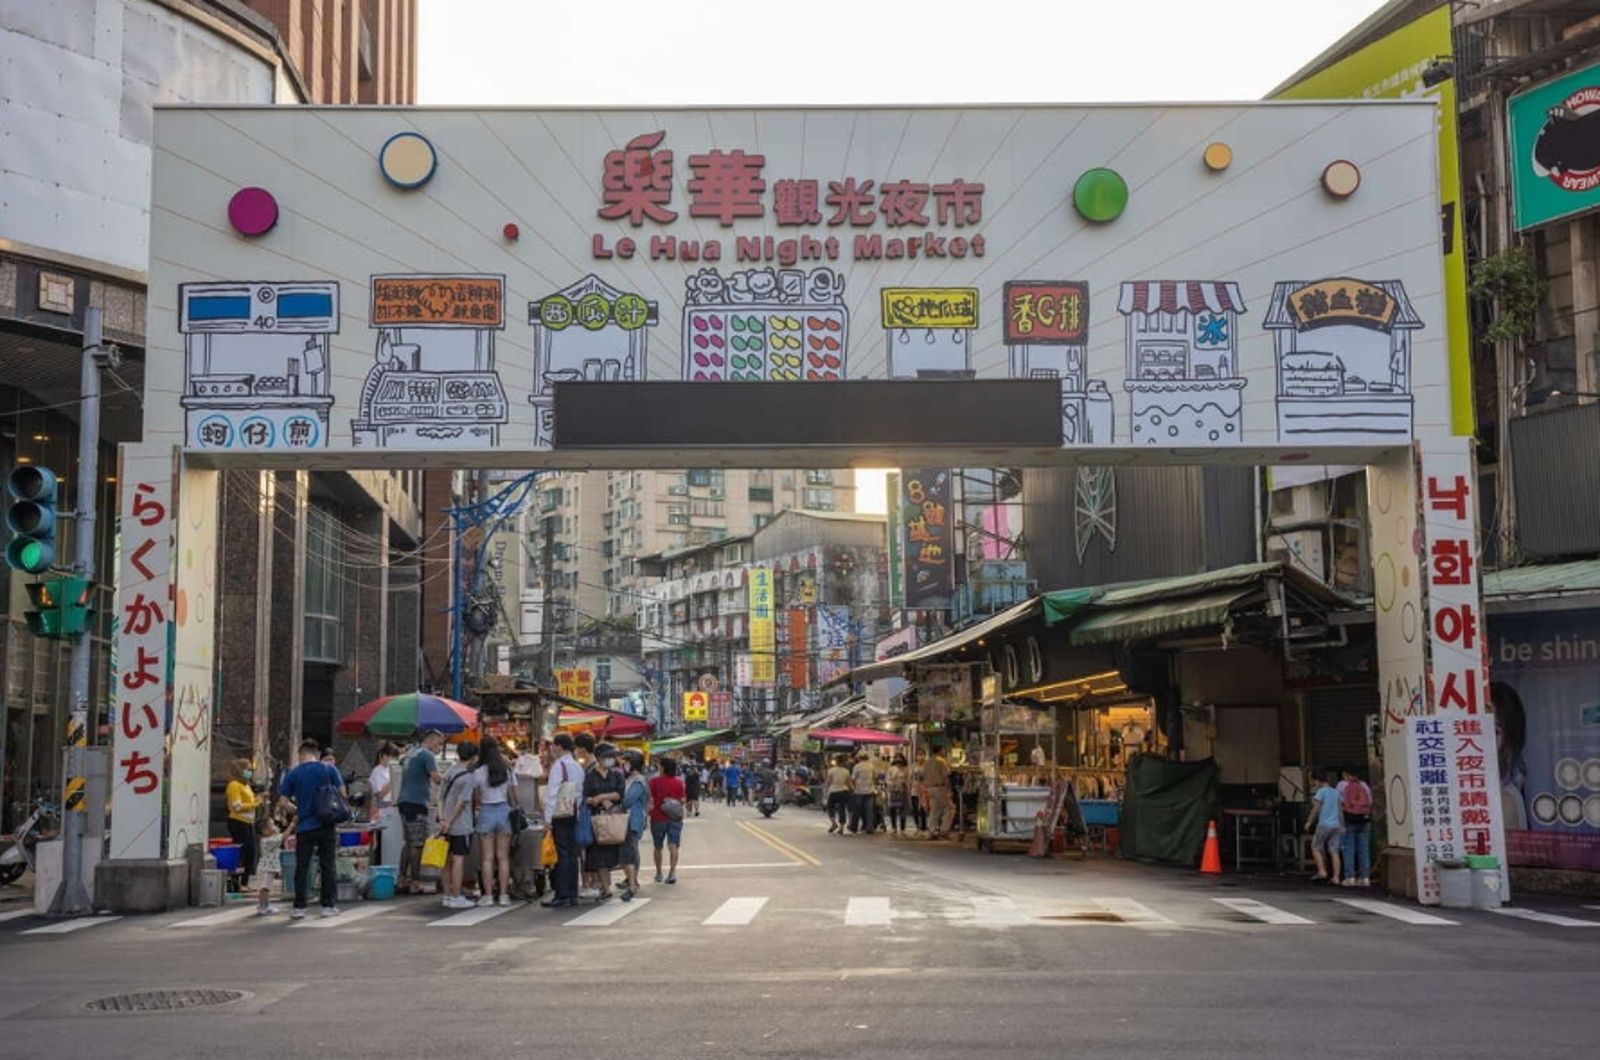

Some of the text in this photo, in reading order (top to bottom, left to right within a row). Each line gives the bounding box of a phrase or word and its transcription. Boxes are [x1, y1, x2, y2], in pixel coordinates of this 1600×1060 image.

[597, 130, 985, 228] 樂華觀光夜市
[592, 233, 986, 266] Le Hua Night Market
[253, 315, 276, 330] 40
[202, 419, 315, 446] 蚵仔煎
[1427, 475, 1477, 715] 낙화야시
[120, 483, 165, 795] らくかよいち
[1500, 636, 1532, 662] be
[1416, 721, 1448, 785] 社交距離
